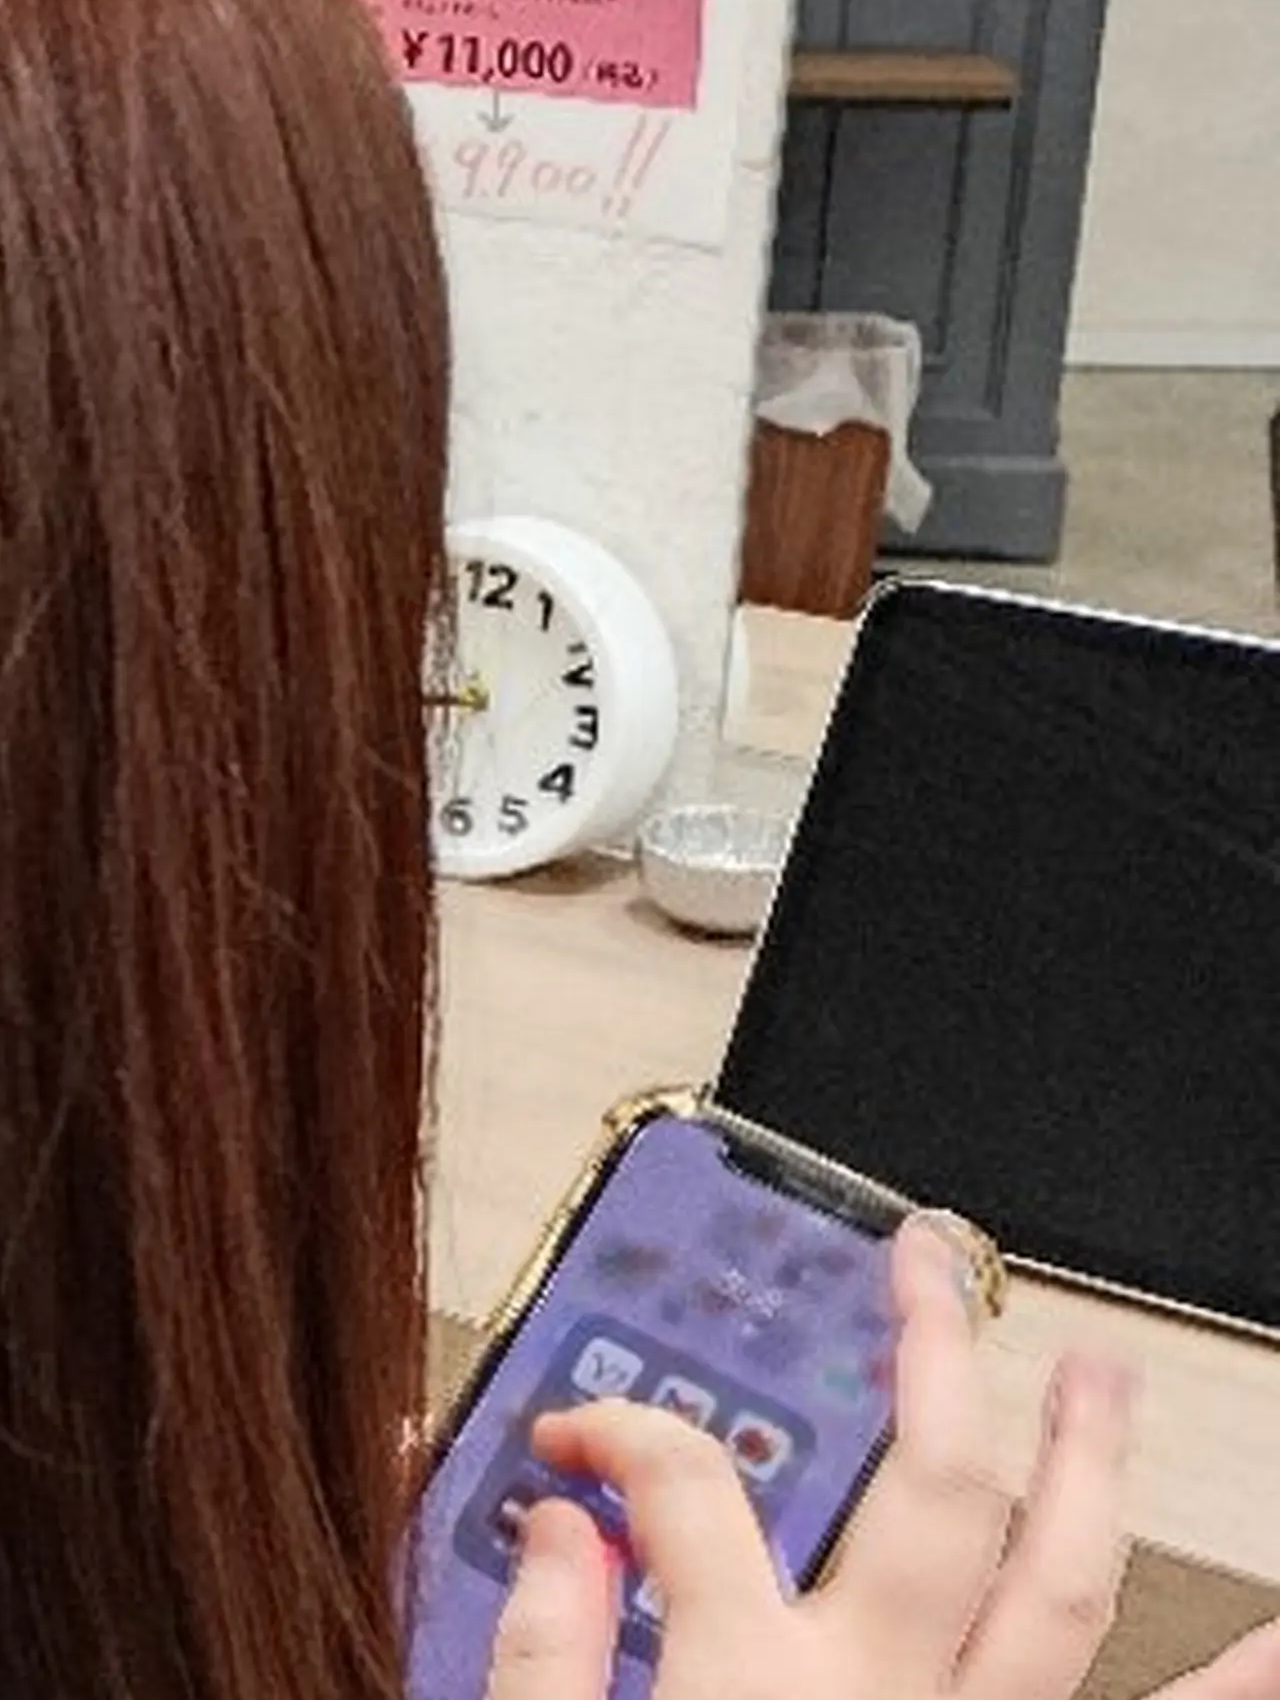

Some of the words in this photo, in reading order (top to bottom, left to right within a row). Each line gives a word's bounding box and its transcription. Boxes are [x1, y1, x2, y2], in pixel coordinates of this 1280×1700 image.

[465, 560, 519, 610] 12
[536, 591, 555, 632] 1
[568, 704, 599, 751] 3
[536, 762, 576, 803] 4
[440, 796, 474, 838] 6
[497, 794, 530, 837] 5
